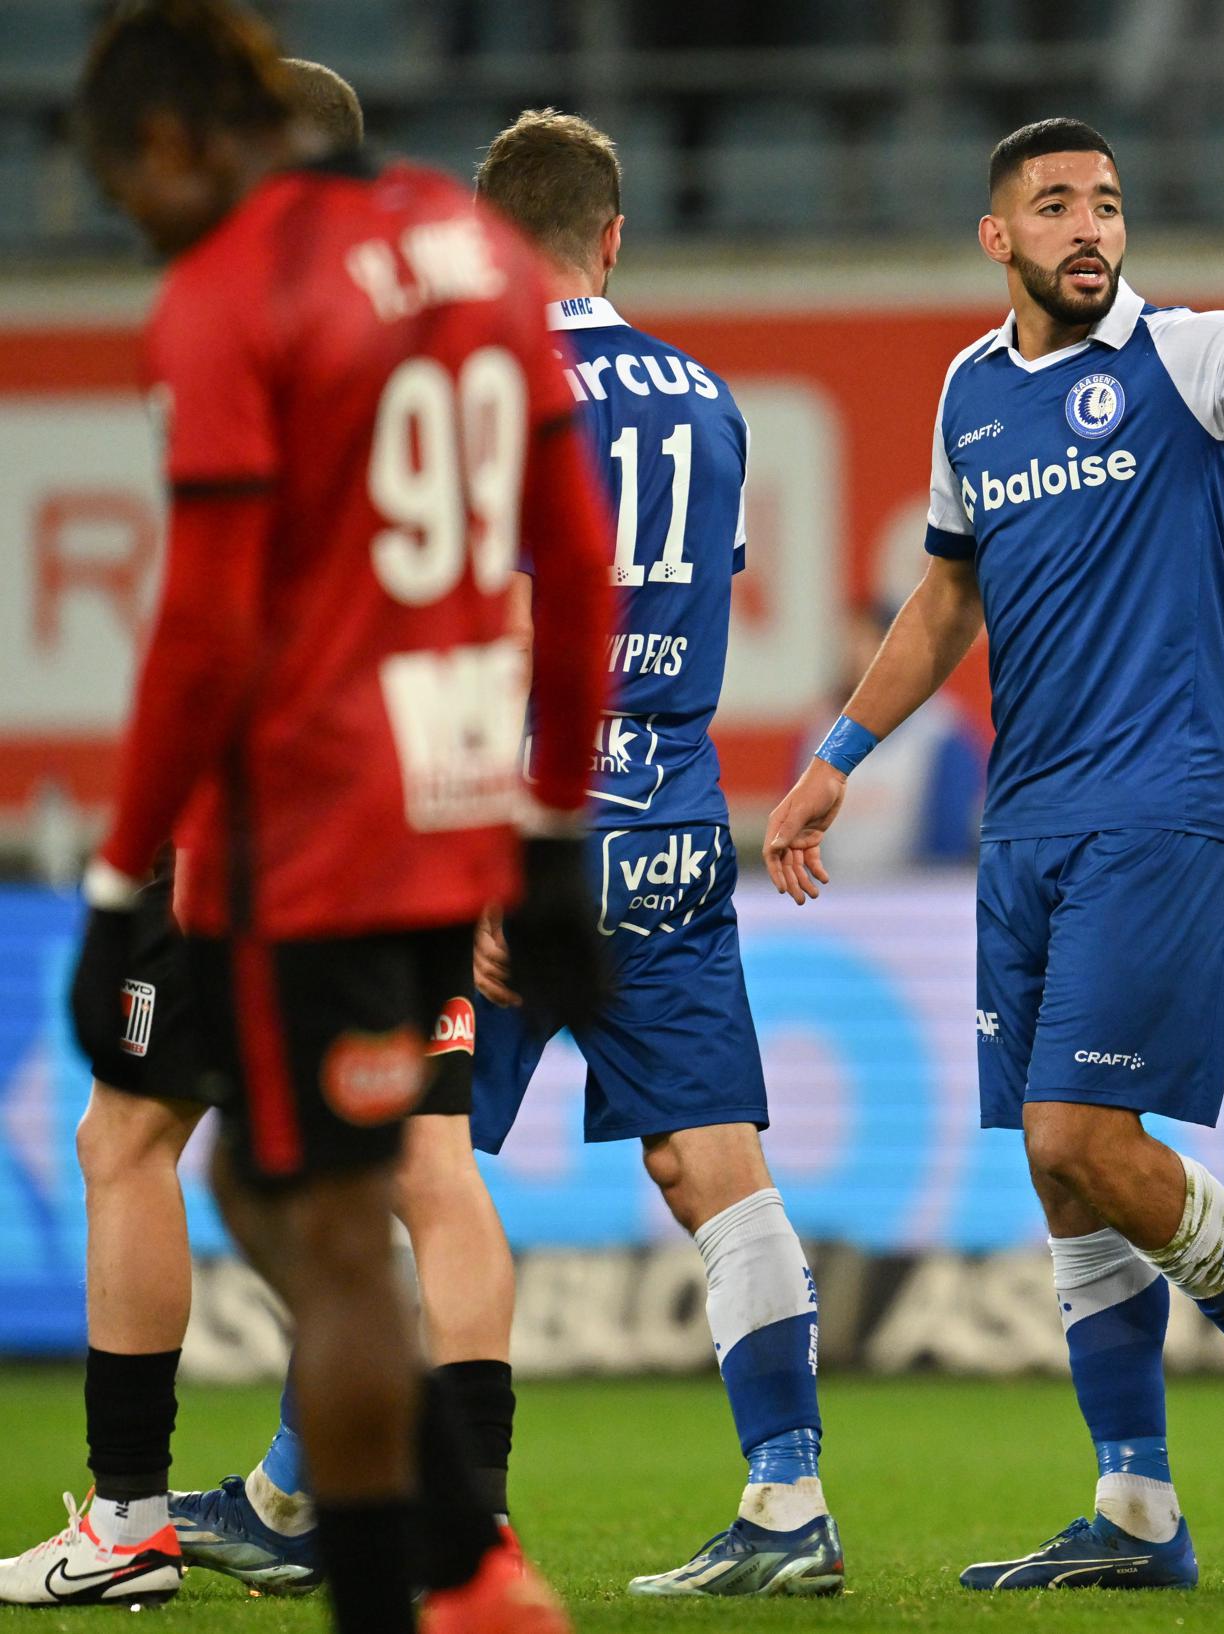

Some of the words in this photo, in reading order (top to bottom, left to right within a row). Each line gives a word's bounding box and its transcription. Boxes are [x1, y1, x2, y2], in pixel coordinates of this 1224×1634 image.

[552, 349, 719, 401] ircus
[1073, 379, 1092, 394] KAA
[1093, 376, 1116, 387] GENT
[958, 424, 993, 448] CRAFT
[982, 446, 1137, 512] baloise
[608, 424, 694, 587] 11
[606, 633, 688, 676] YPERS
[620, 834, 708, 891] vdk
[121, 981, 153, 996] WD
[430, 1013, 475, 1041] DAL
[1074, 1050, 1132, 1067] CRAFT
